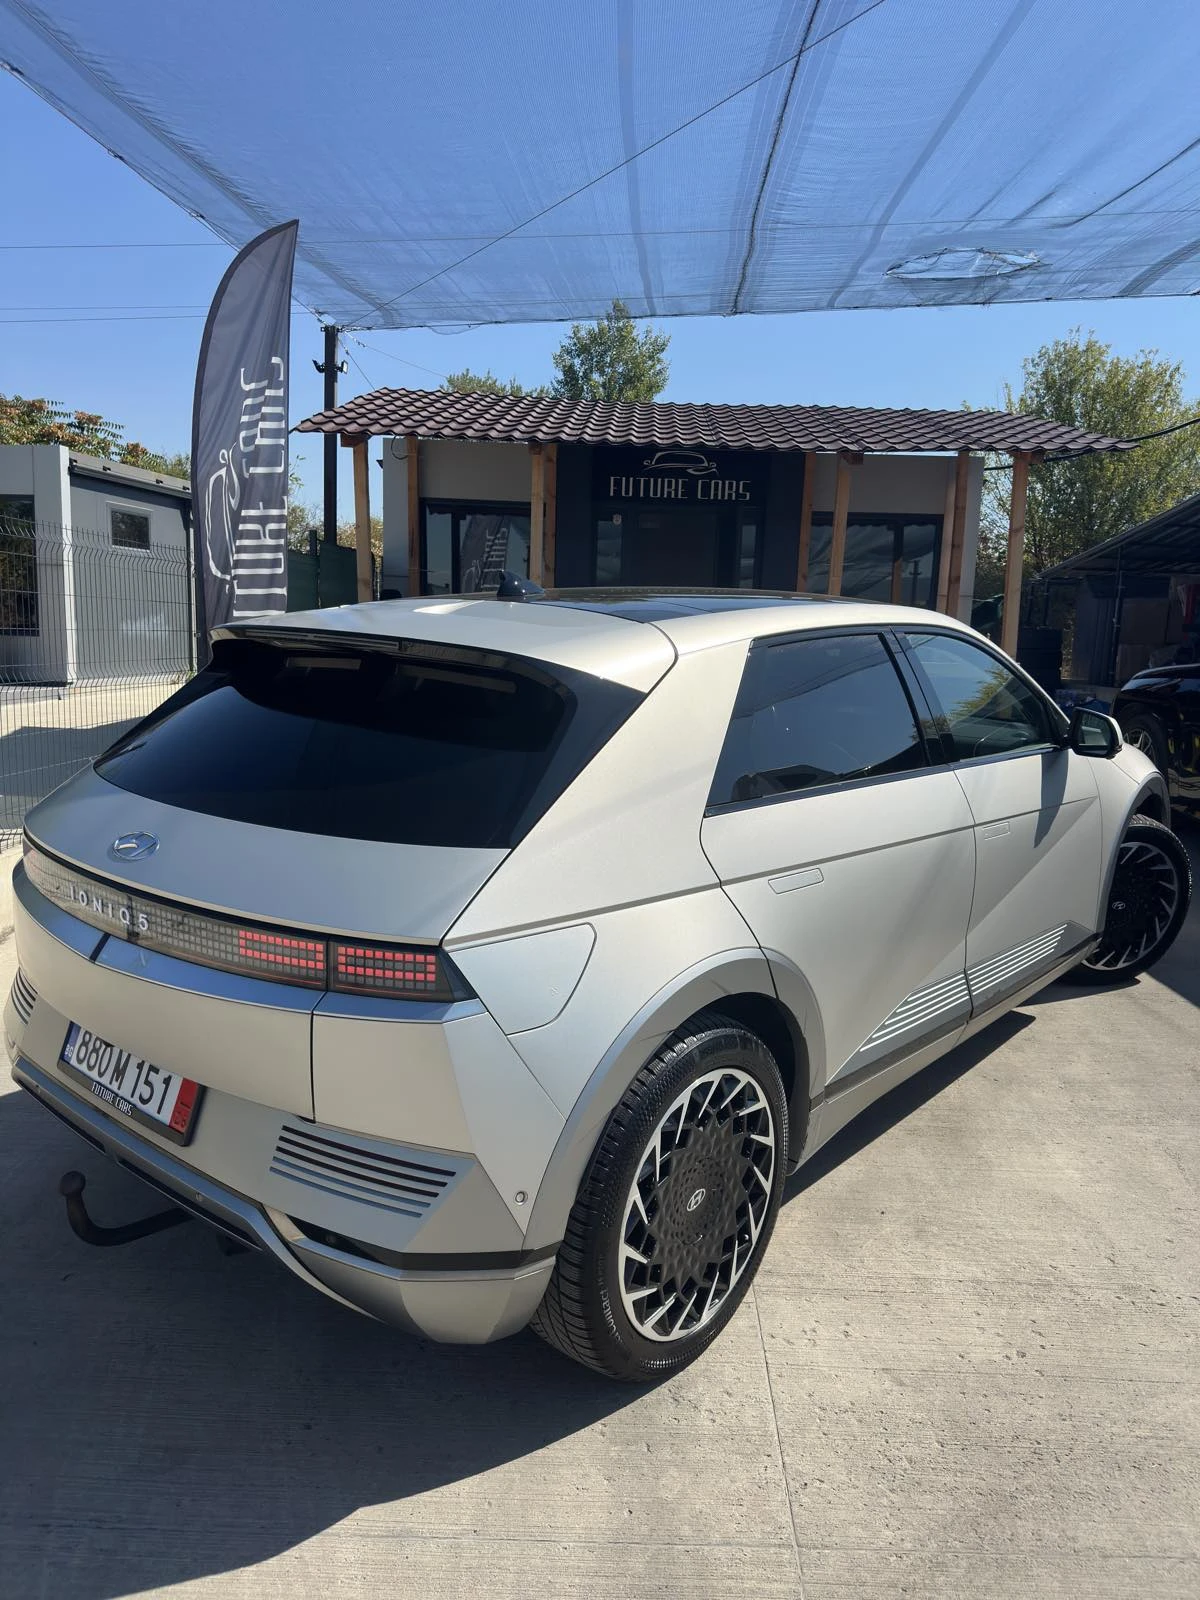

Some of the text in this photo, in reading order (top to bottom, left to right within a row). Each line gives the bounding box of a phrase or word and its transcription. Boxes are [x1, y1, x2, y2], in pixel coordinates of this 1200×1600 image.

[609, 476, 751, 501] FUTURE CARS
[70, 886, 149, 931] IONIQ 5
[91, 1081, 134, 1116] FUTURE CARS
[130, 1060, 173, 1115] 151
